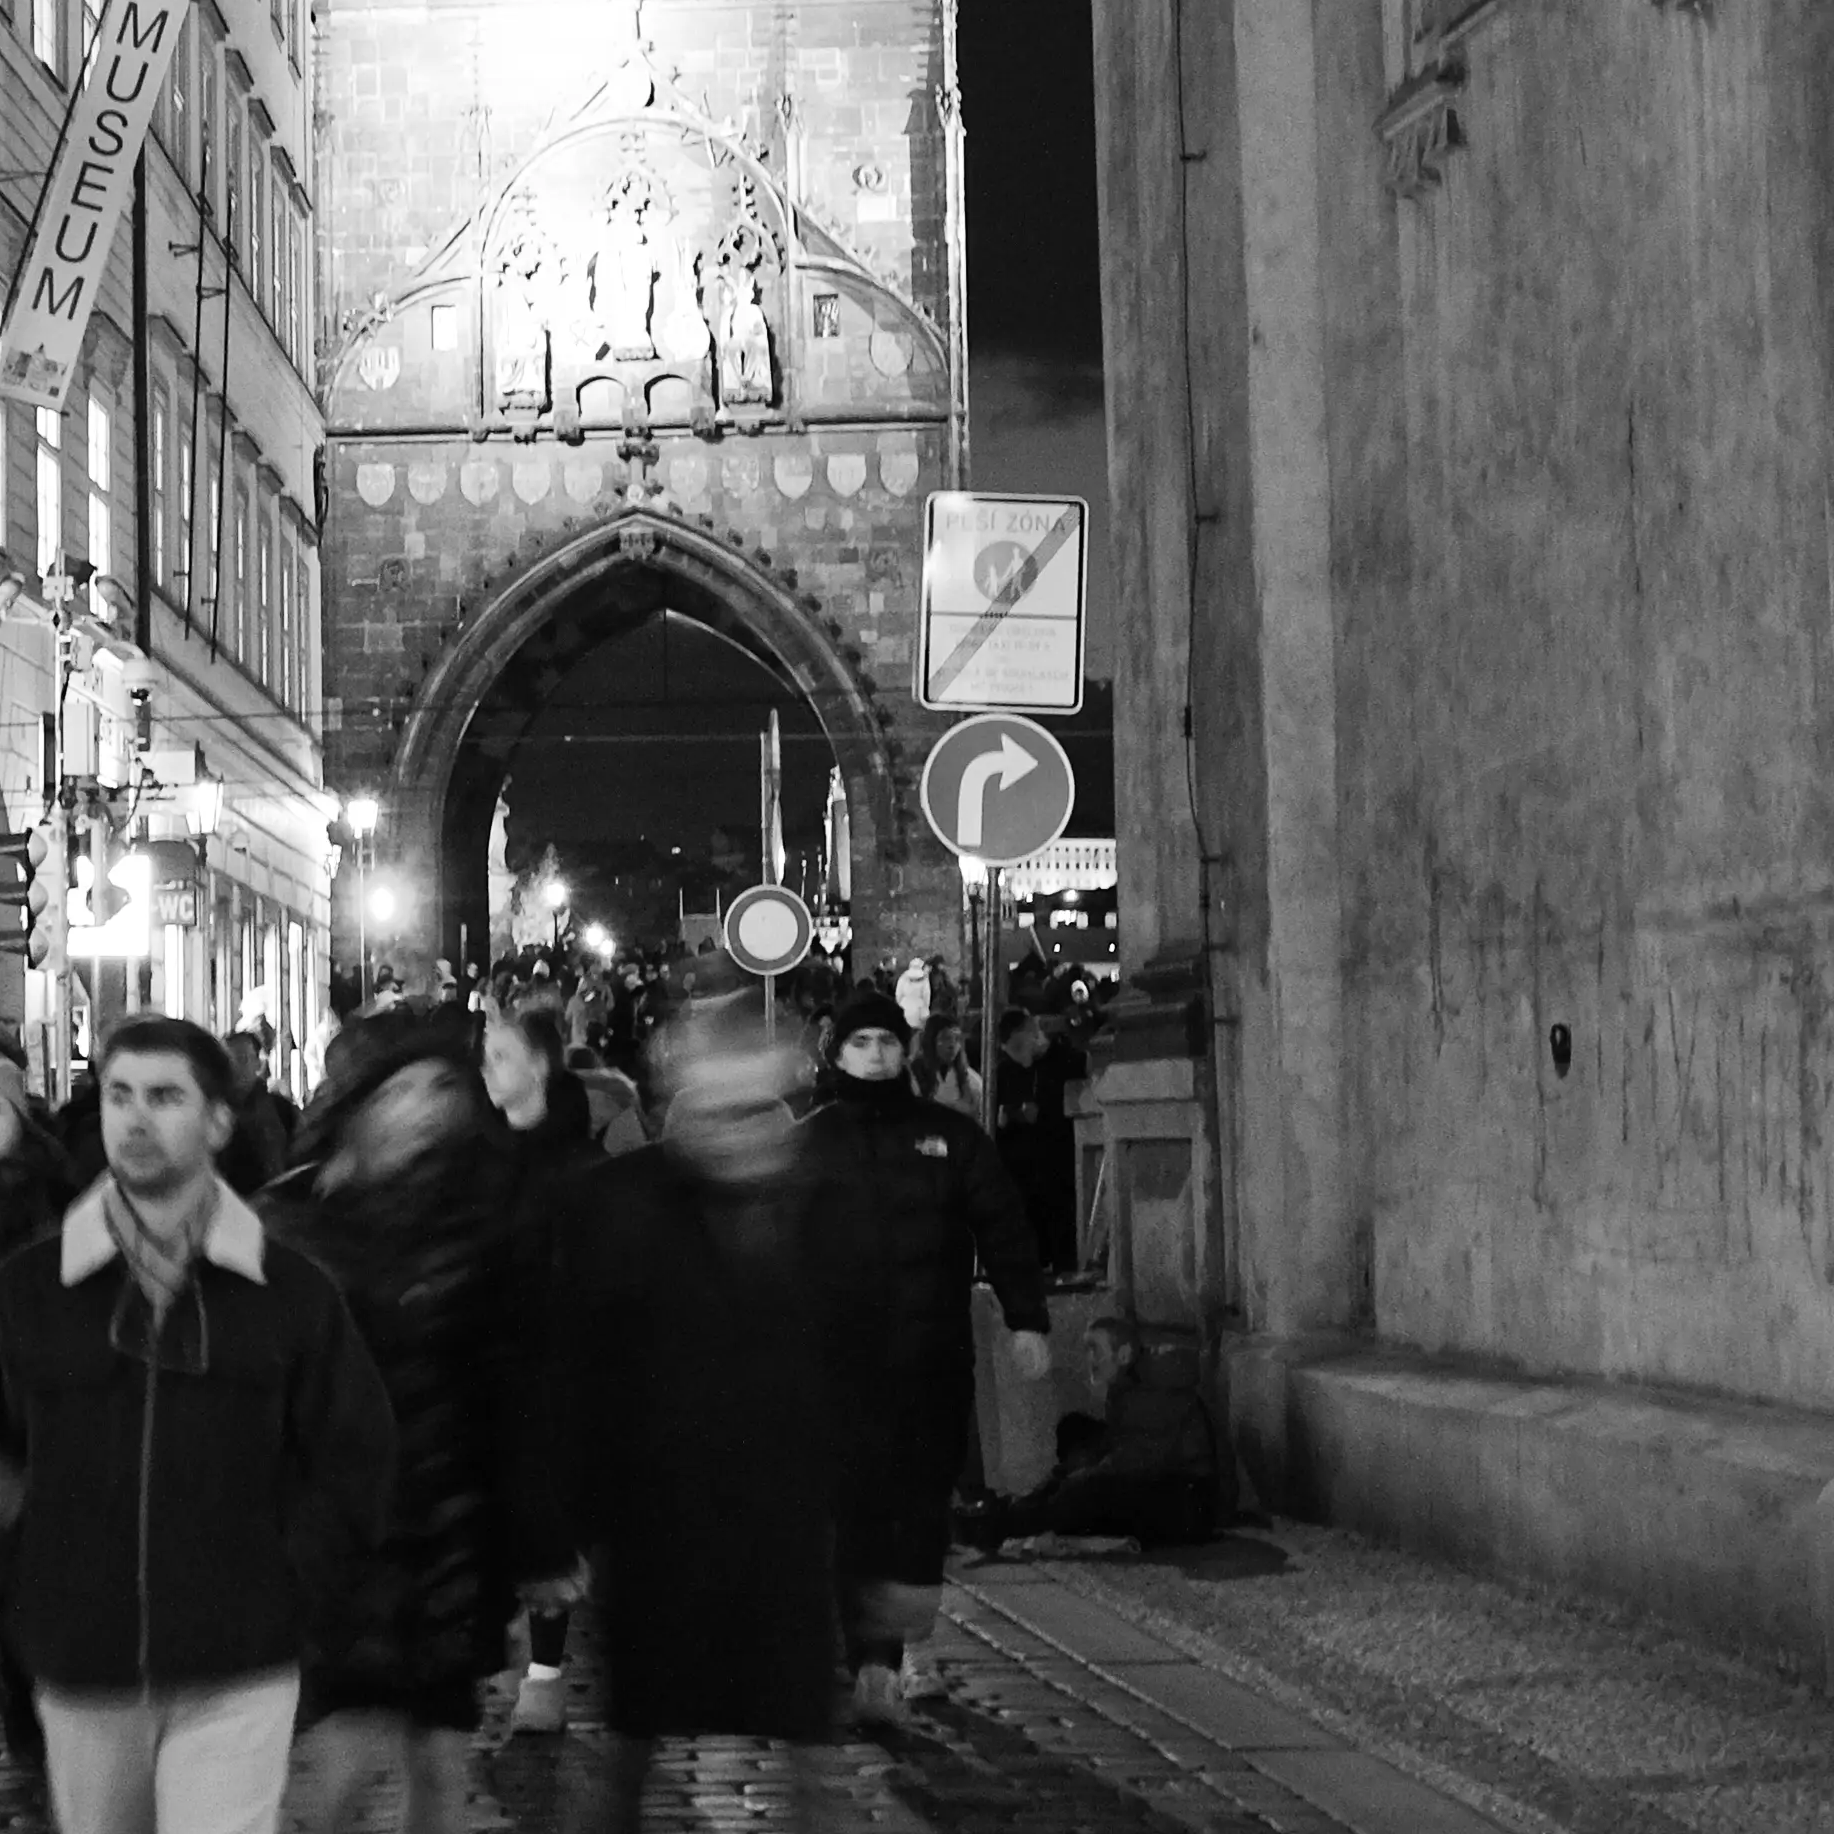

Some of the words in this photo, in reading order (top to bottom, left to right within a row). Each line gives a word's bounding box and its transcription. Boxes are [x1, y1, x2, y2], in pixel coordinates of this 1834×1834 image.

[31, 0, 169, 320] MUSEUM
[1005, 510, 1066, 533] ZÓNA
[157, 893, 195, 921] WC
